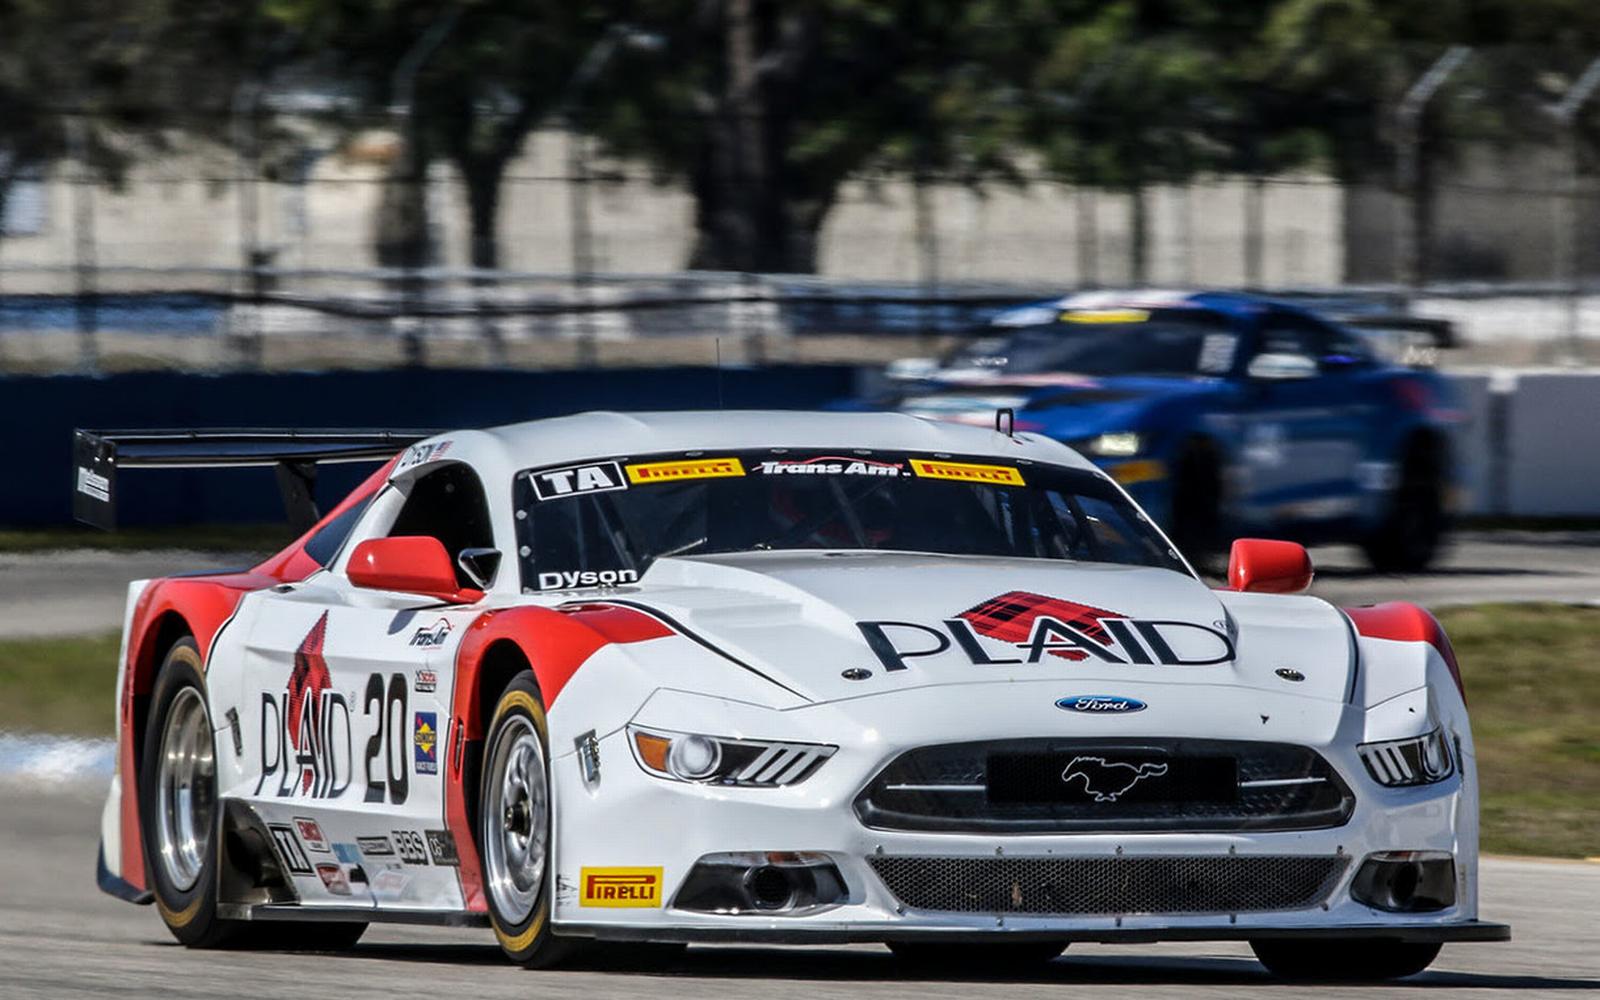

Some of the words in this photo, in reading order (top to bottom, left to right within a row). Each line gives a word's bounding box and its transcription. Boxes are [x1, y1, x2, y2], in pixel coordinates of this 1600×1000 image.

[542, 466, 614, 494] TA
[638, 463, 732, 478] PIRELLI
[761, 461, 841, 474] Trans
[921, 463, 1013, 482] PIRELLI
[539, 569, 638, 590] Dyson
[856, 618, 1237, 672] PLAID
[1076, 697, 1129, 712] Ford
[254, 689, 352, 799] PLAID
[364, 673, 409, 805] 20
[273, 830, 310, 870] TA
[392, 830, 427, 861] BBS
[587, 875, 656, 900] PIRELLI
